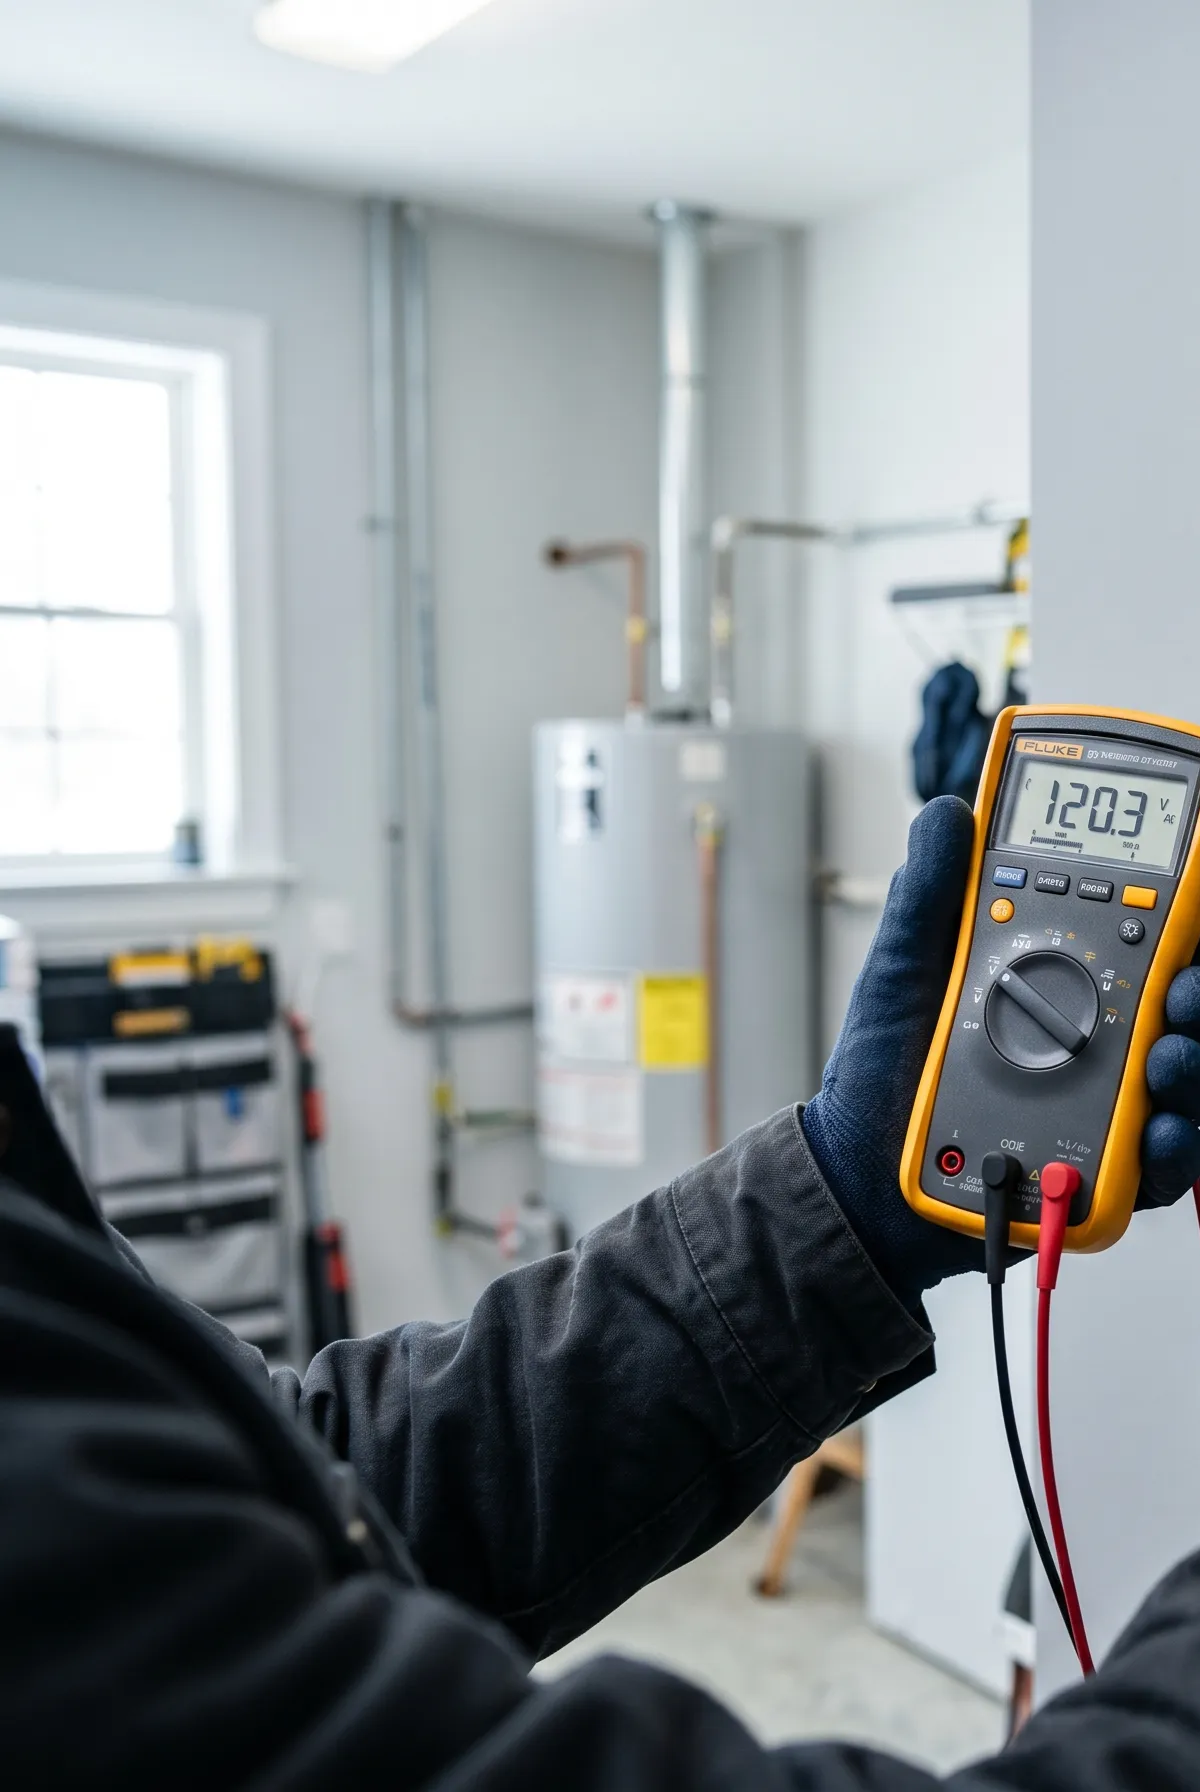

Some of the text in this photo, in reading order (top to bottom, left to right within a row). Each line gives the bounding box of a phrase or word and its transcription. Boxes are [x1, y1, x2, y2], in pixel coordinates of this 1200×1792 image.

[1023, 741, 1080, 757] FLUKE
[1045, 779, 1149, 838] 120.3
[1160, 797, 1170, 812] V
